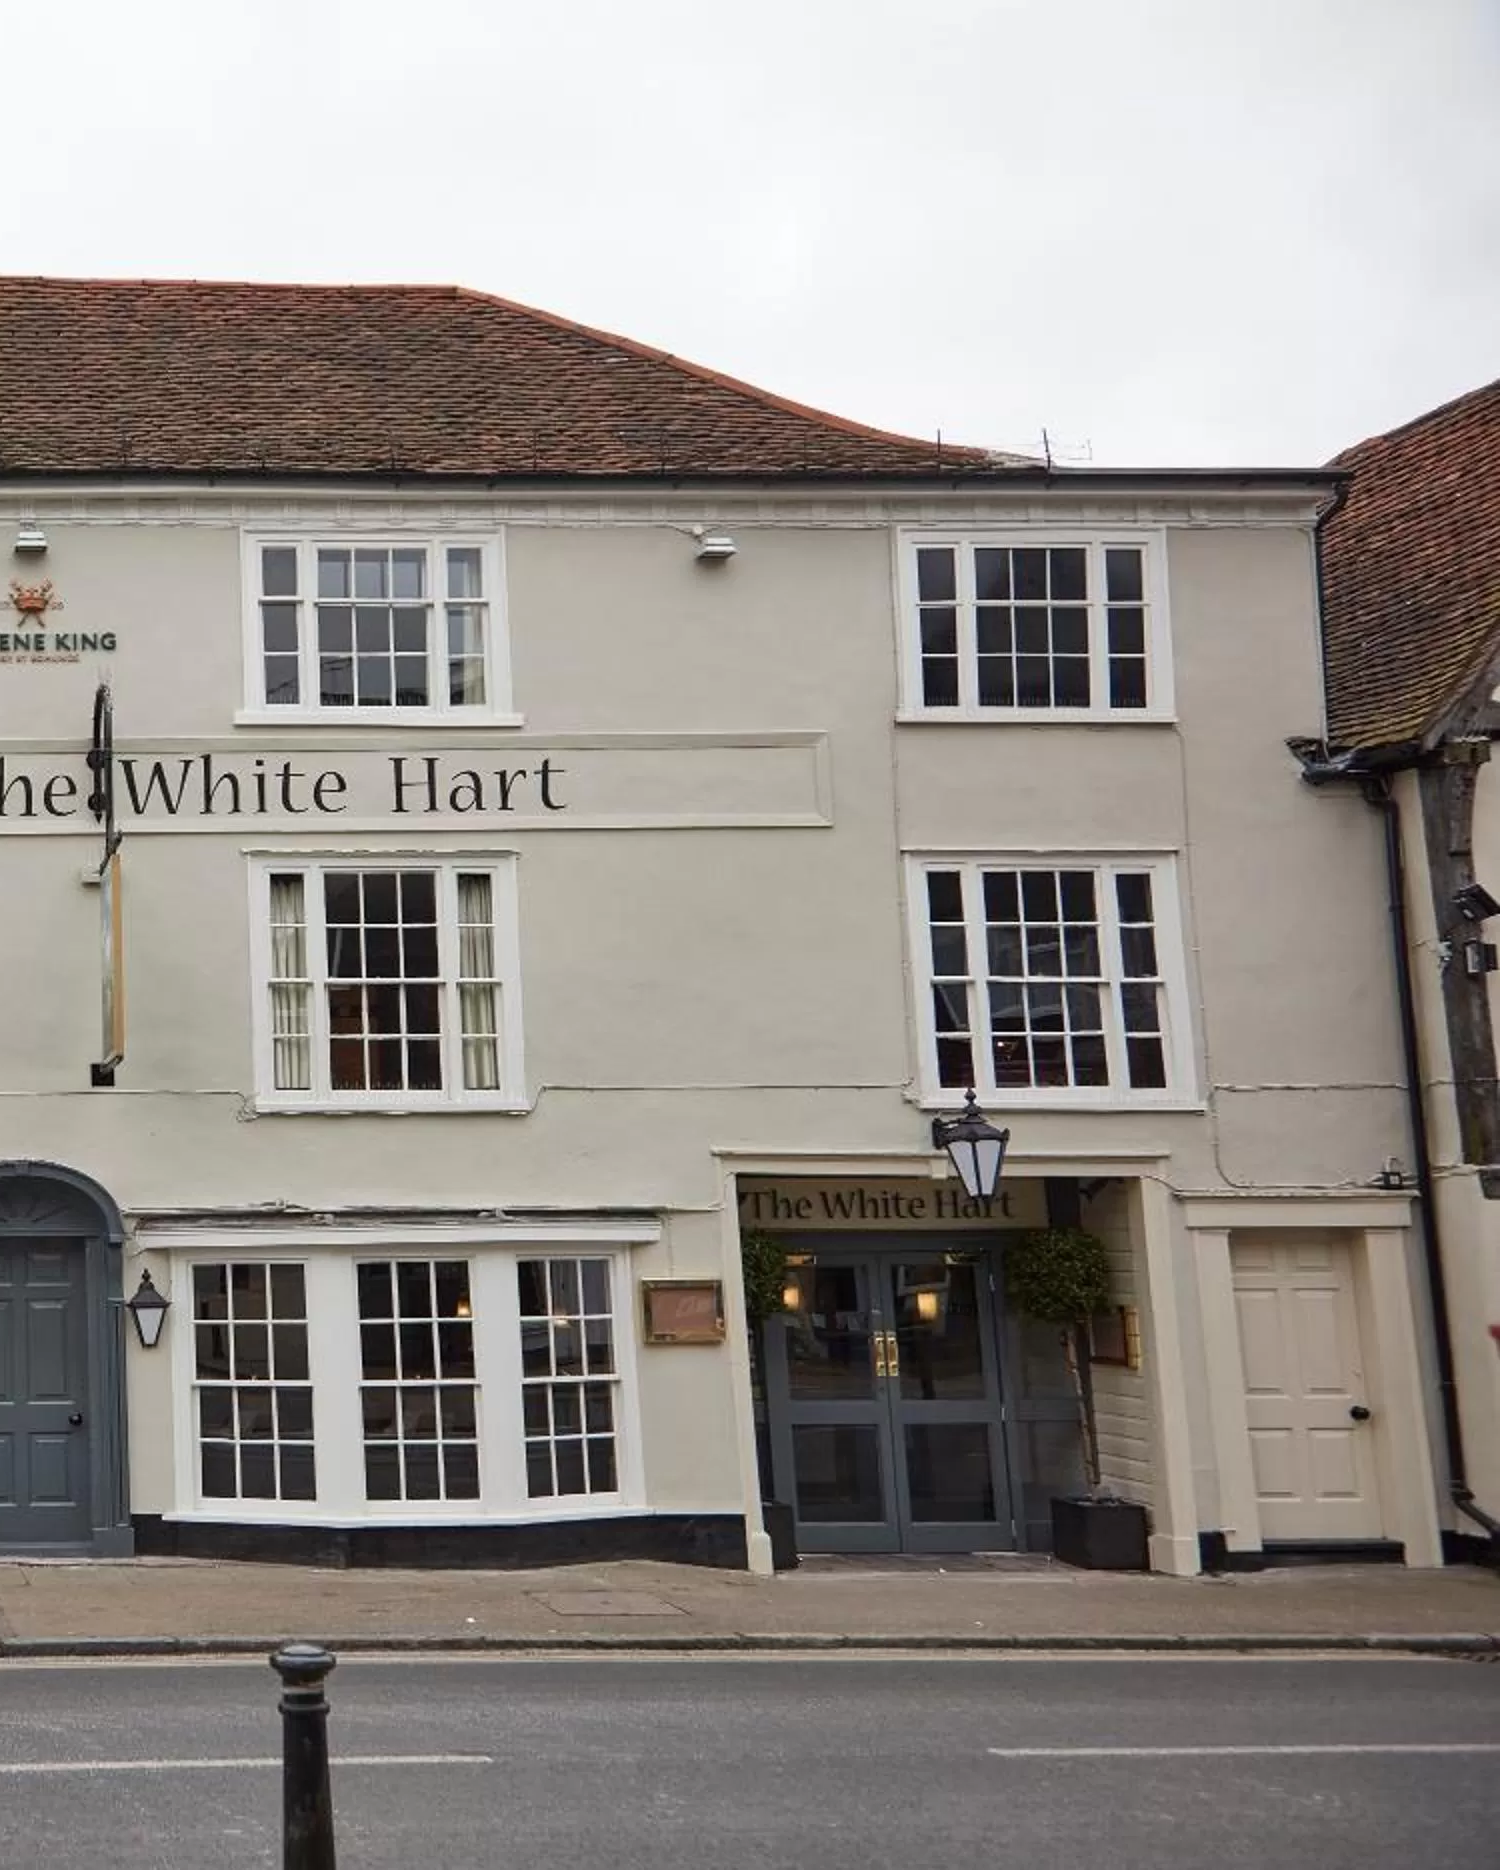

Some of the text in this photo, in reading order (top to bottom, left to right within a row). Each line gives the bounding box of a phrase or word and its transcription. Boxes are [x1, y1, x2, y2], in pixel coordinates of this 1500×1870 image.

[55, 632, 117, 652] KING
[117, 753, 347, 814] White
[388, 757, 567, 813] Hart
[747, 1188, 1017, 1220] The White Hart
